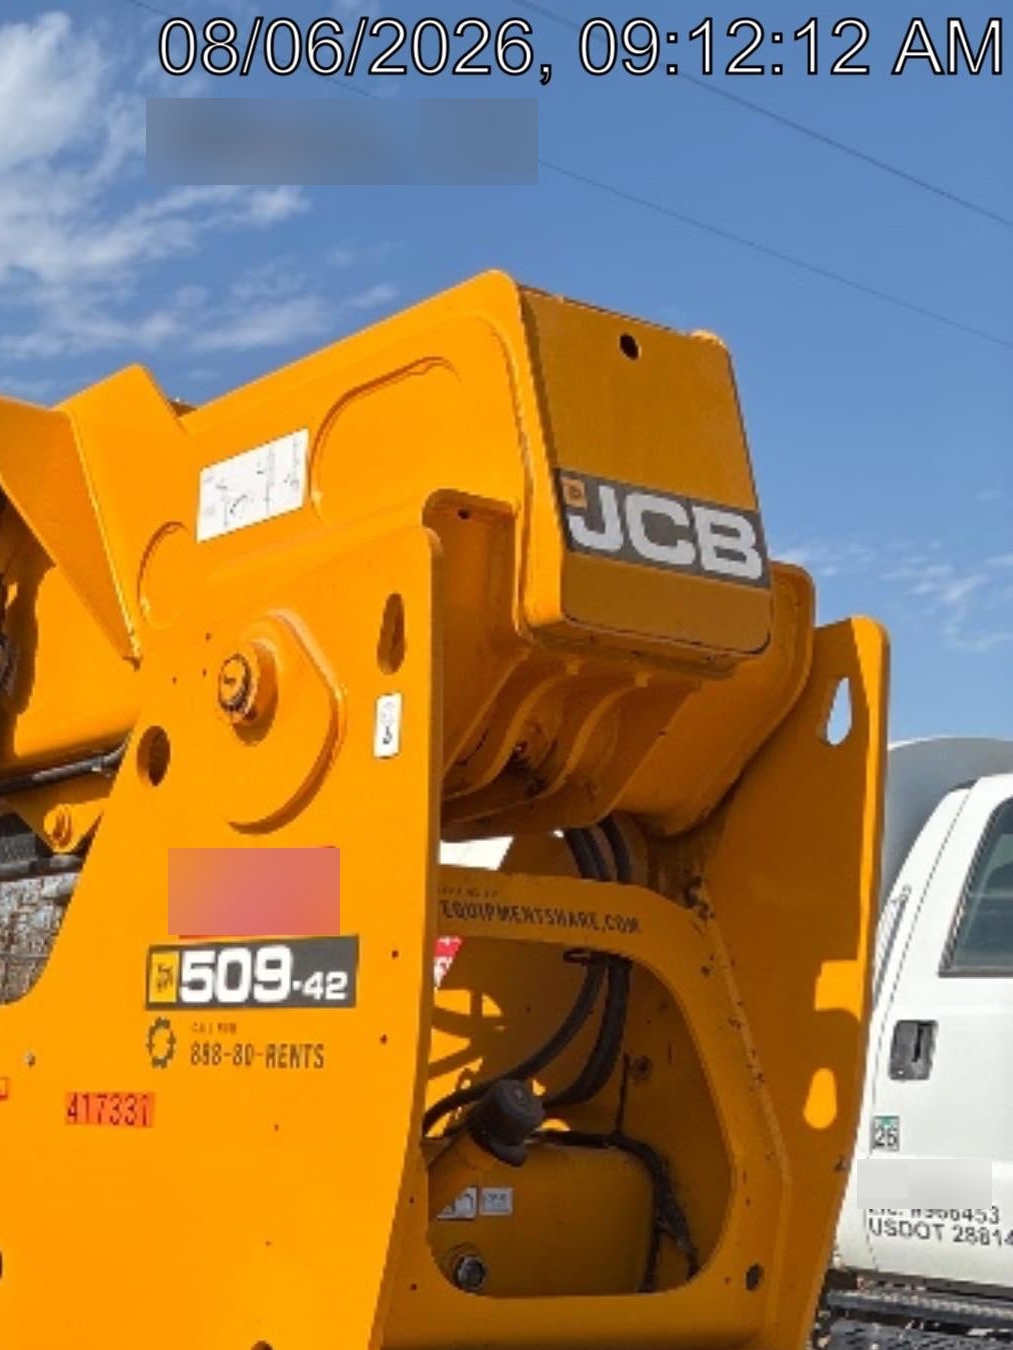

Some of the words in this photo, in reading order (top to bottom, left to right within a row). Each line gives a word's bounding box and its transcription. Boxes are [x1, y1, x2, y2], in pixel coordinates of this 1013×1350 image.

[568, 485, 763, 580] JCB
[67, 1093, 149, 1128] 417331
[868, 1217, 945, 1241] USDOT
